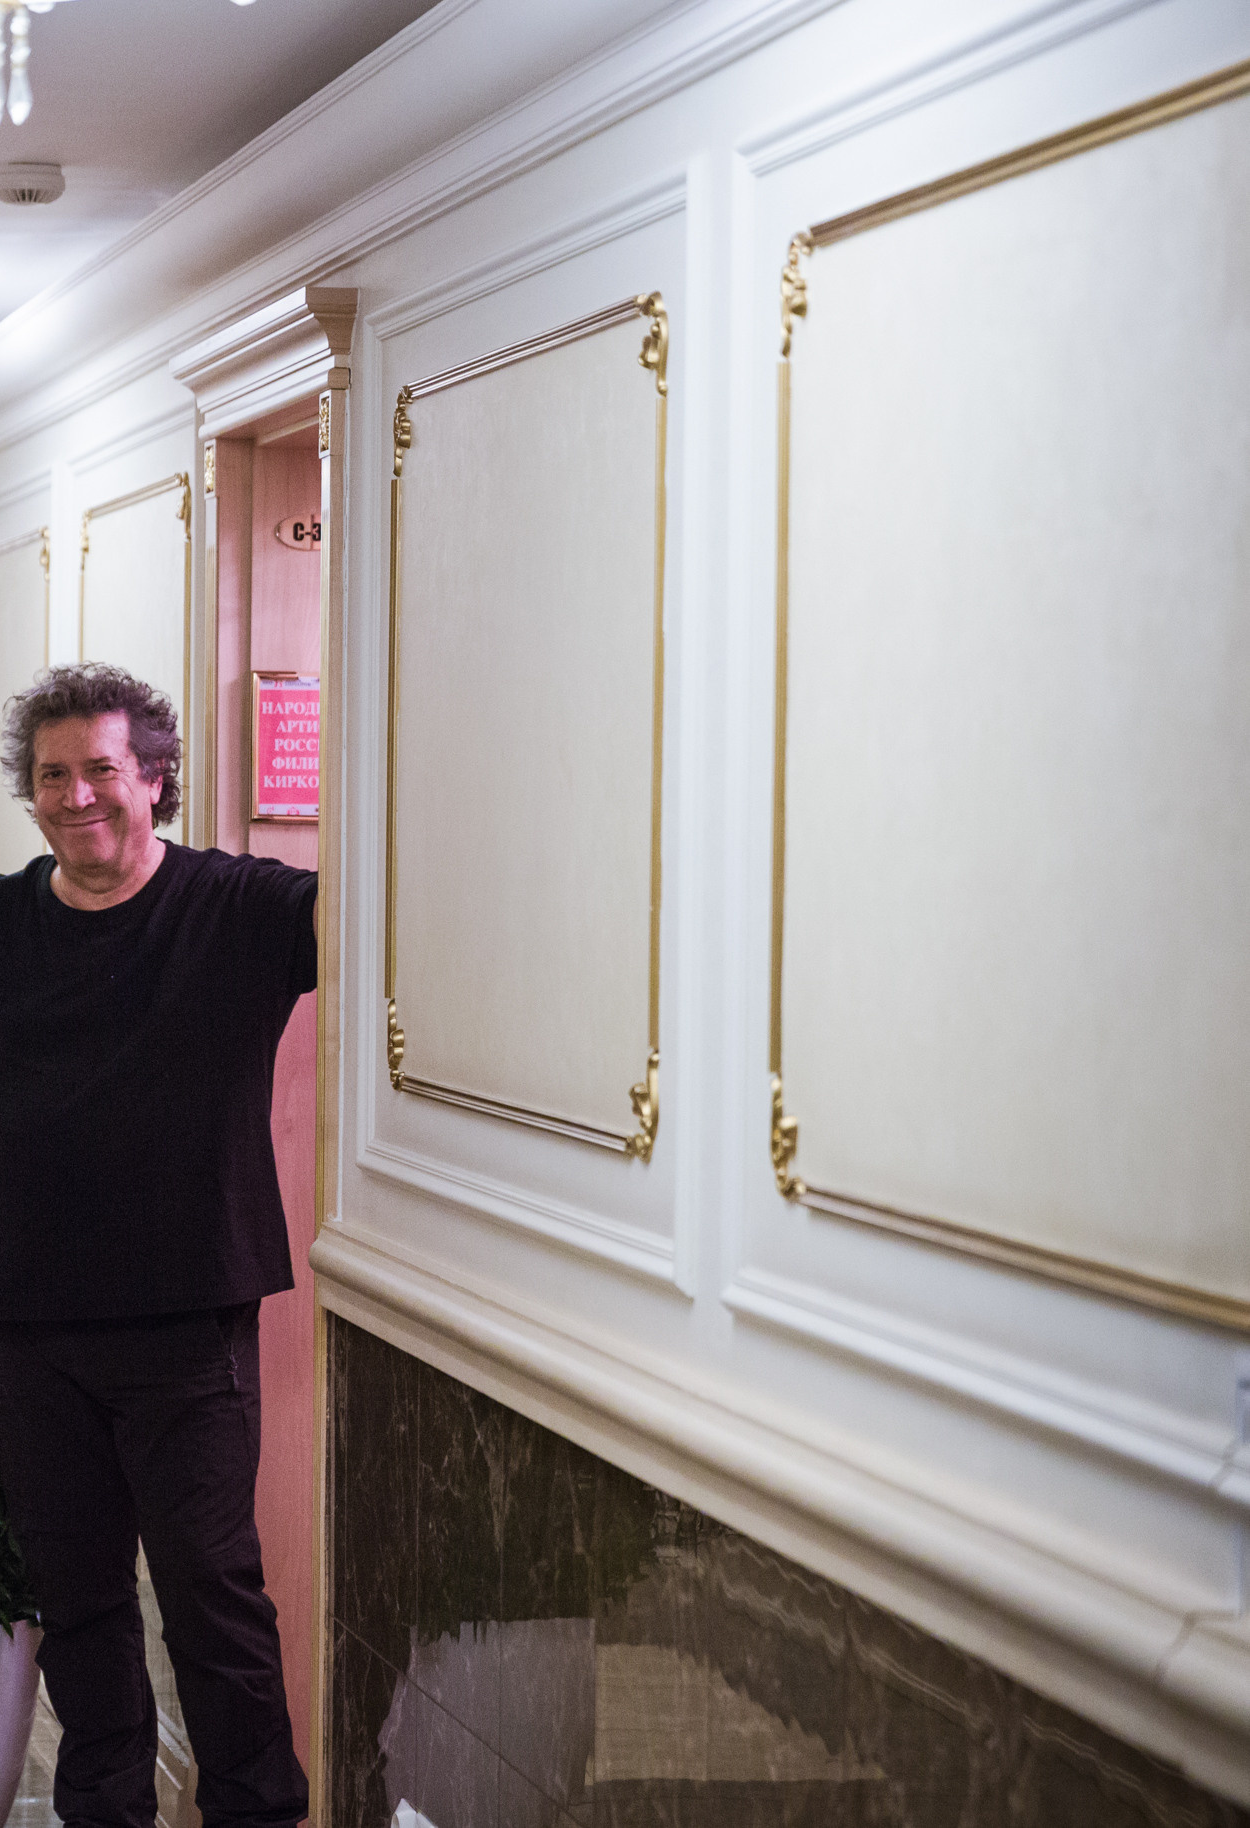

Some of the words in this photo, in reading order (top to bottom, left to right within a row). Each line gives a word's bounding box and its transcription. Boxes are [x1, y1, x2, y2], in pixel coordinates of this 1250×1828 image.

[276, 720, 320, 733] АРТИ
[274, 738, 320, 752] РОСС
[272, 757, 319, 770] ФИЛИ
[263, 775, 319, 788] КИРКО
